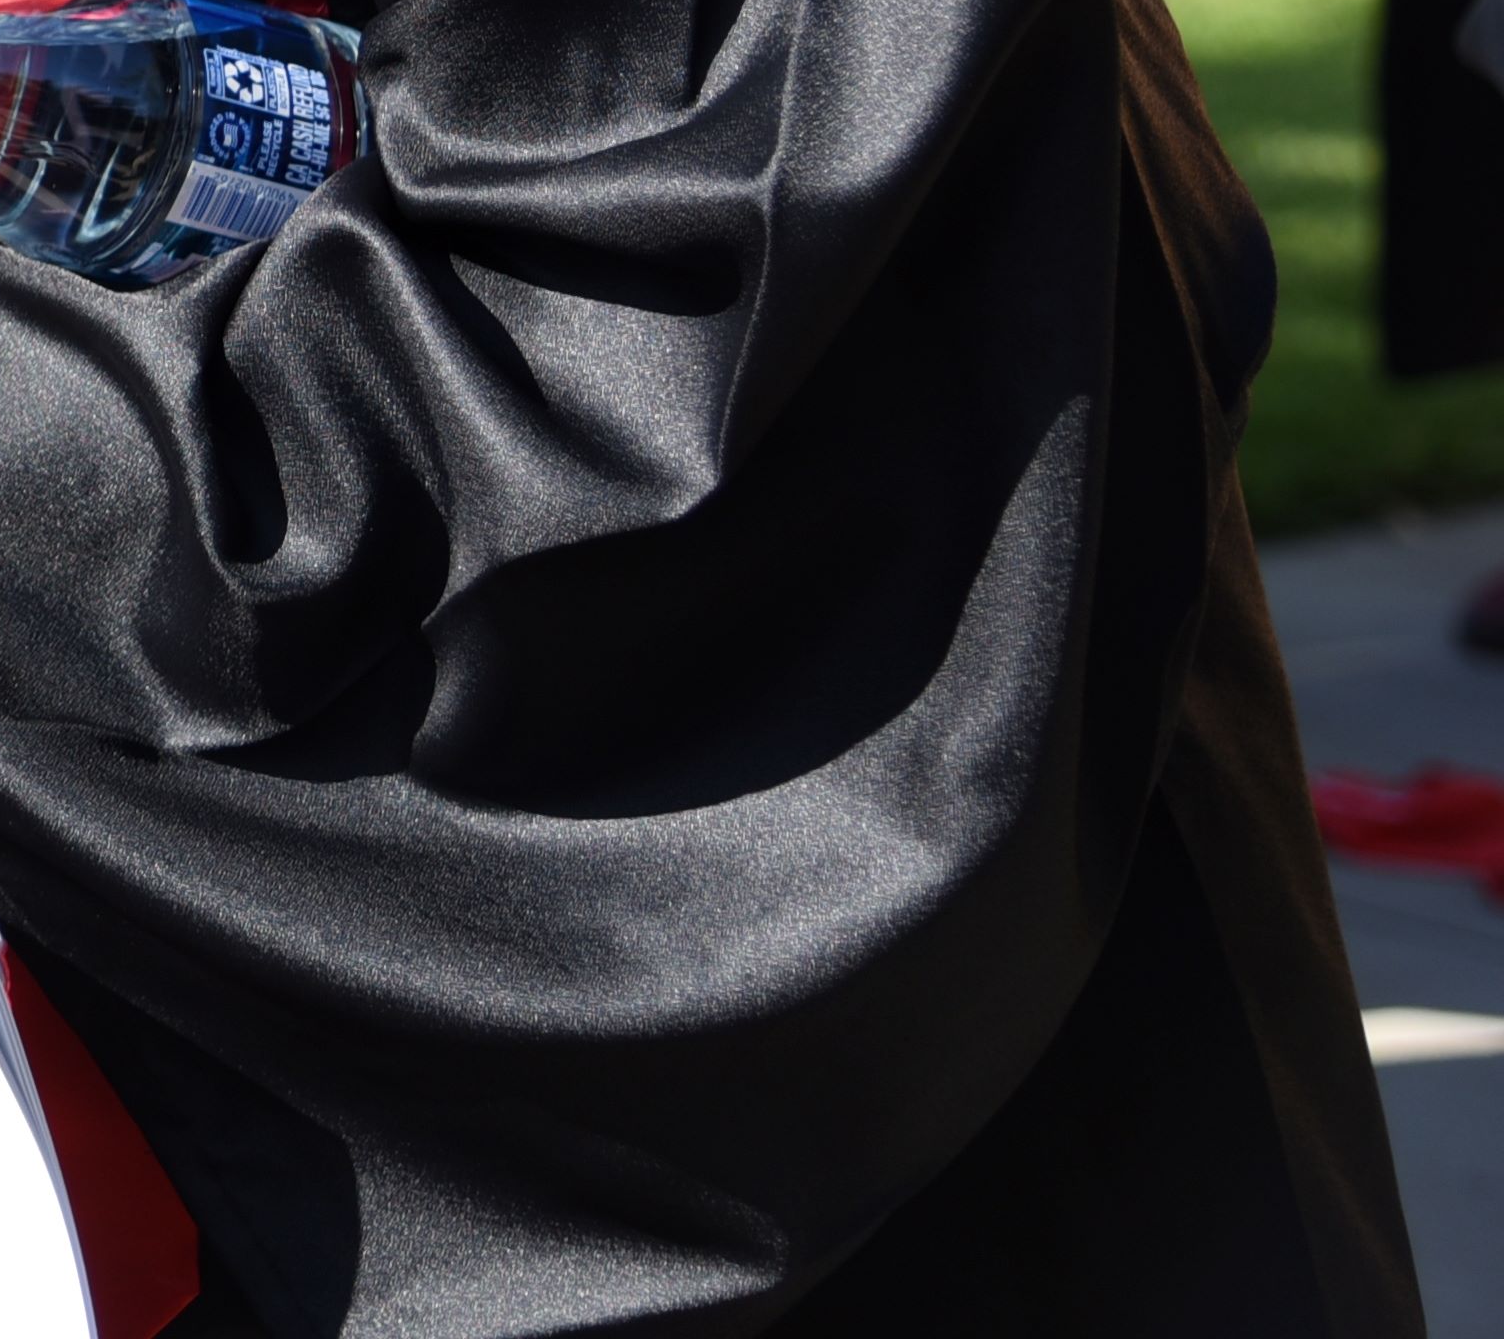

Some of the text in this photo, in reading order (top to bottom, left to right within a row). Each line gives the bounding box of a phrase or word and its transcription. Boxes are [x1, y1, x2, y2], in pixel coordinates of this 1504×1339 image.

[257, 120, 273, 170] PLEASE
[265, 118, 284, 178] RECYCLE
[285, 63, 315, 185] CA CASH REFUND
